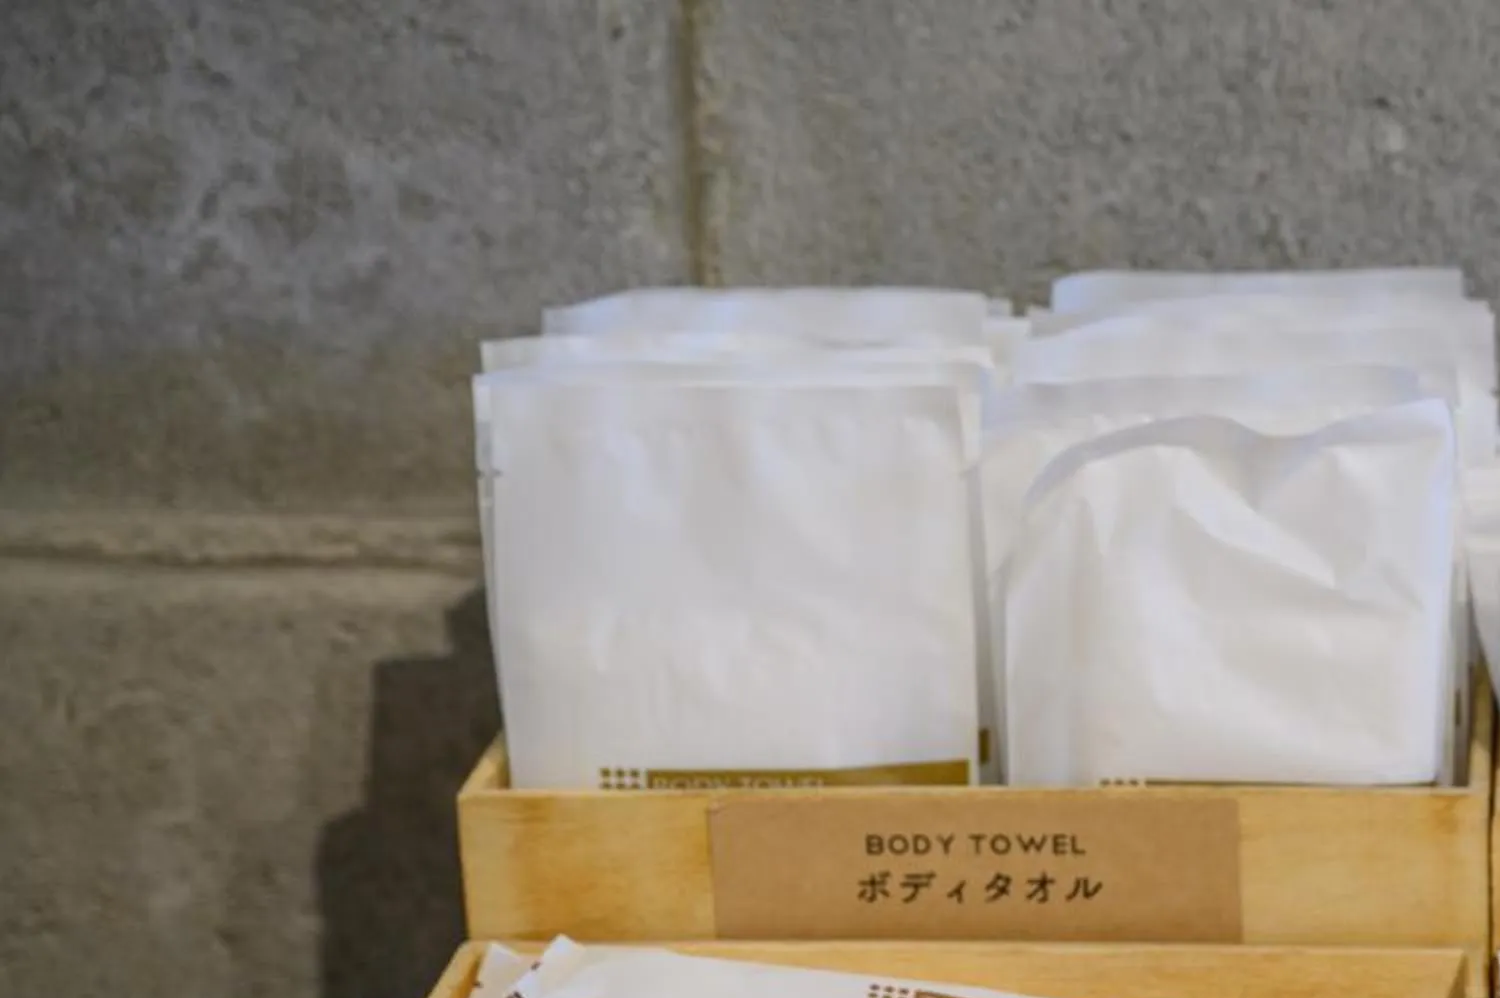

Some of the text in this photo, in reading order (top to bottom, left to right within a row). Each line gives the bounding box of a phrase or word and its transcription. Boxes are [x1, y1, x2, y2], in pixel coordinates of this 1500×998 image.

[865, 833, 1087, 856] BODY TOWEL
[857, 870, 1104, 903] ボディタオル
